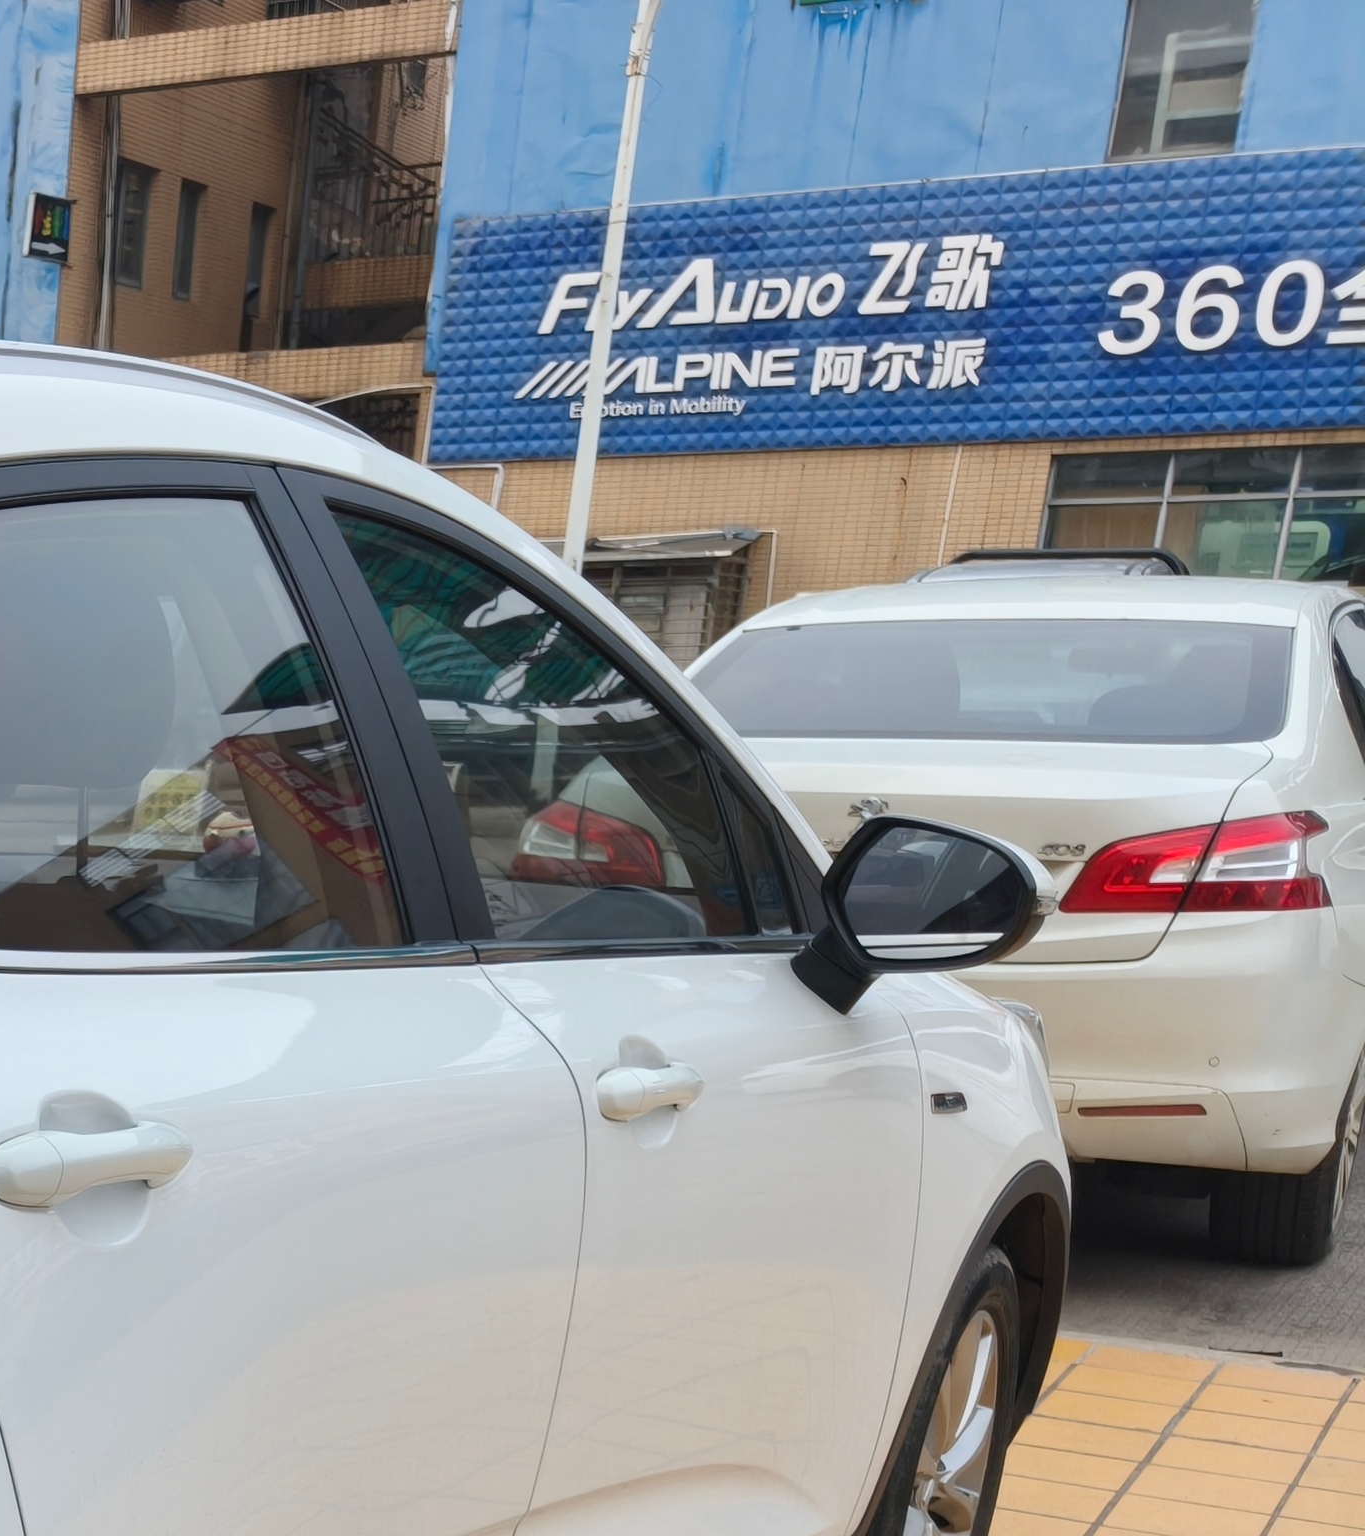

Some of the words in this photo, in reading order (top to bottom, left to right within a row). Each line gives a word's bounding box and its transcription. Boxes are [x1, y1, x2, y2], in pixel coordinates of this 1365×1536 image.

[857, 234, 1005, 315] 飞歌
[602, 349, 800, 395] ALPINE
[810, 338, 987, 396] 阿尔派
[569, 400, 644, 419] Eotion
[648, 397, 665, 416] in
[670, 395, 747, 416] Mobility
